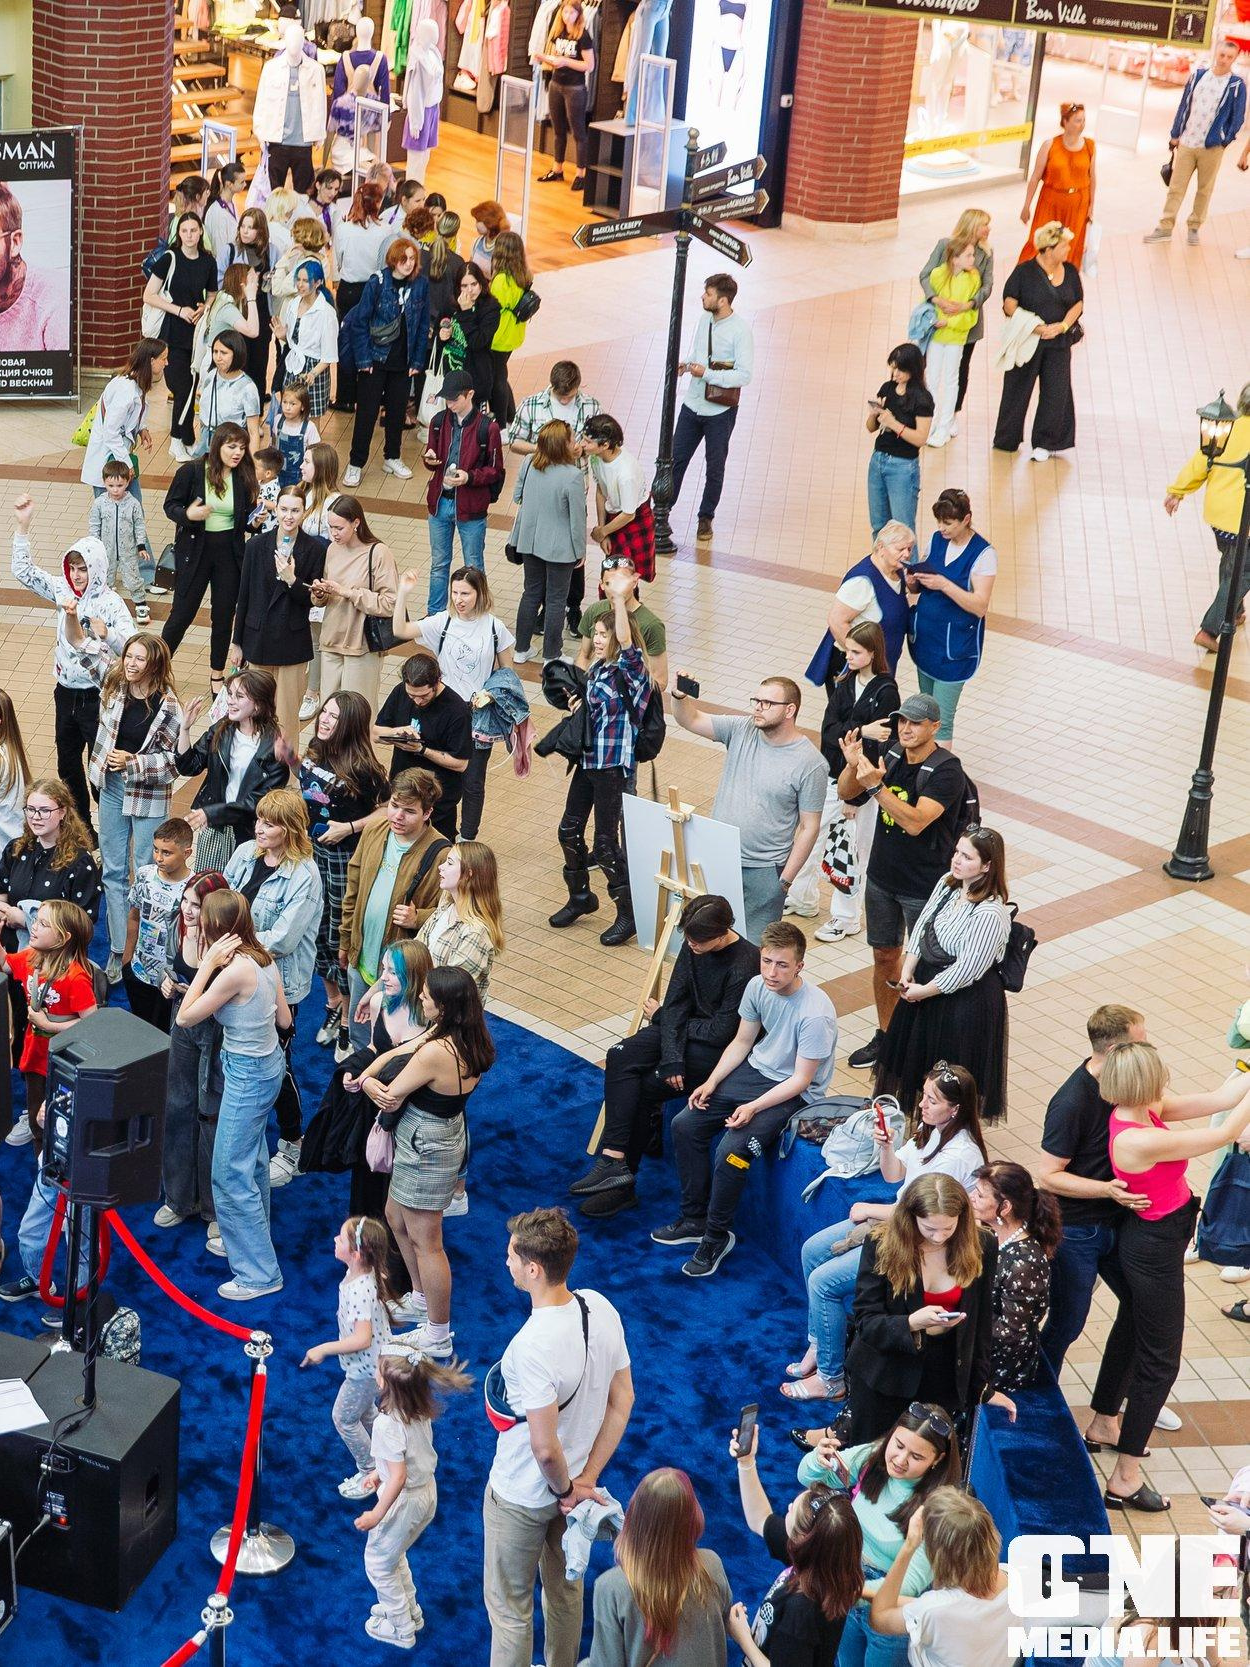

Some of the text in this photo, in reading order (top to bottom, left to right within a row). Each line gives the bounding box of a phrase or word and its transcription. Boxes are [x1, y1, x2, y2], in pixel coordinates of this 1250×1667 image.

[1026, 0, 1087, 25] Bon Ville
[1184, 13, 1193, 31] 1
[18, 161, 55, 170] ОПТИКА
[22, 368, 53, 377] ОЧКОВ
[9, 378, 53, 387] BECKHAM
